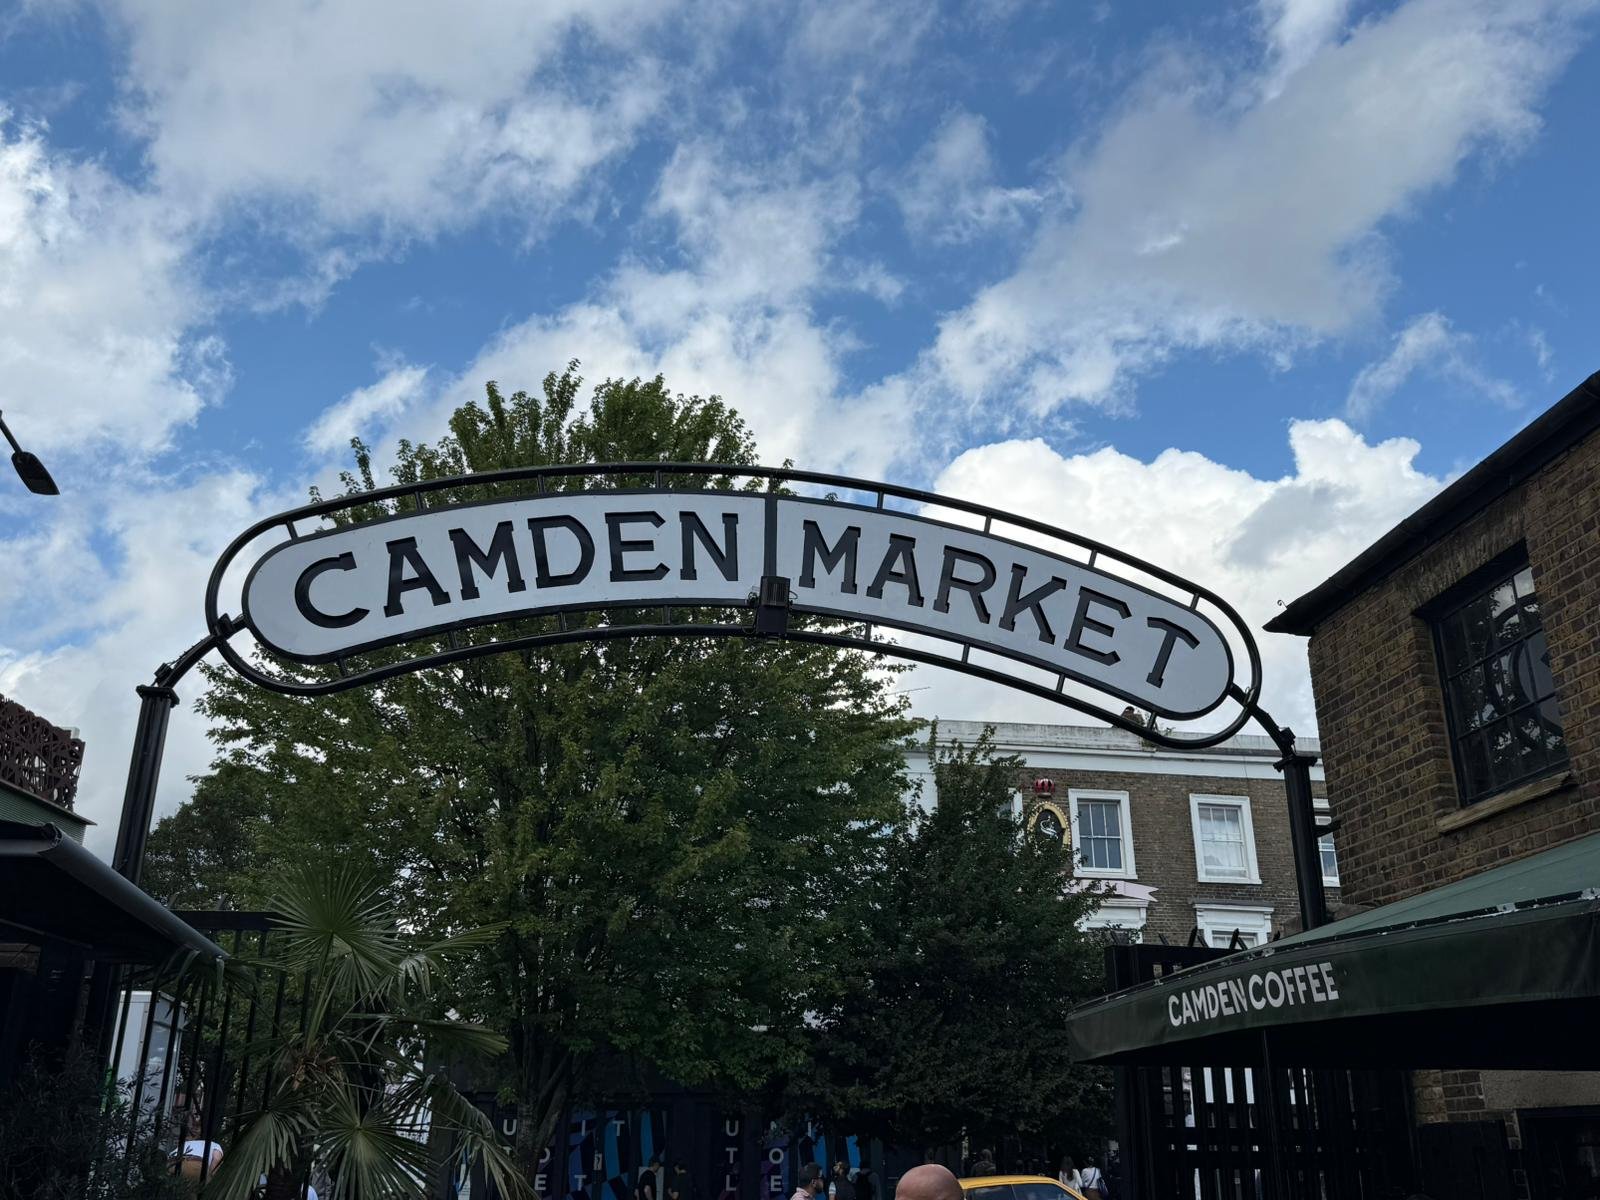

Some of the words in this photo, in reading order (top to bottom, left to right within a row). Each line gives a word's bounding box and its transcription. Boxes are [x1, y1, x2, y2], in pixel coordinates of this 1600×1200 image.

[294, 510, 739, 629] CAMDEN
[799, 519, 1200, 688] MARKET
[1168, 977, 1248, 1027] CAMDEN
[1249, 962, 1339, 1010] COFFEE
